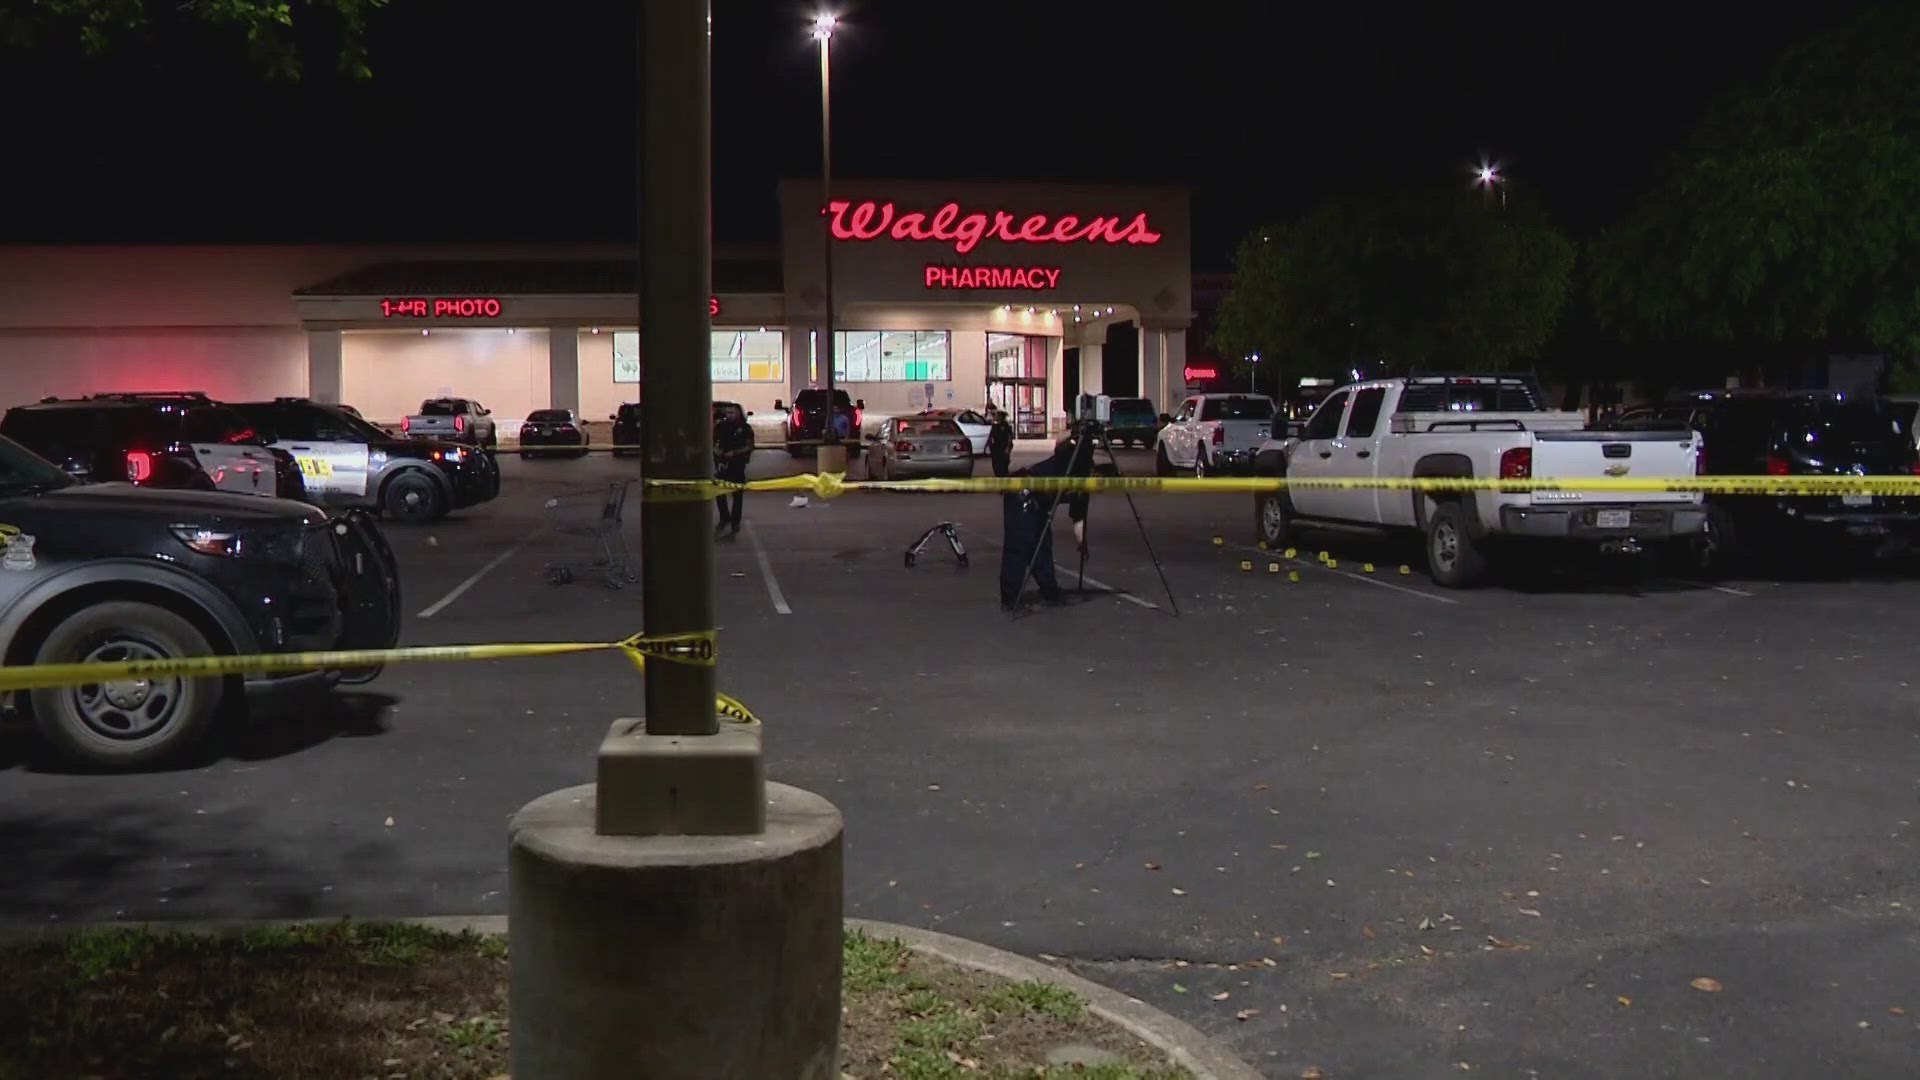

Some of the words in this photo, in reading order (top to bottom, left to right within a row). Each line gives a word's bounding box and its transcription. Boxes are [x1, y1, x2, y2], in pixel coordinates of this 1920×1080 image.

[823, 201, 1161, 253] Walgreens
[925, 266, 1061, 289] PHARMACY
[434, 299, 500, 316] PHOTO
